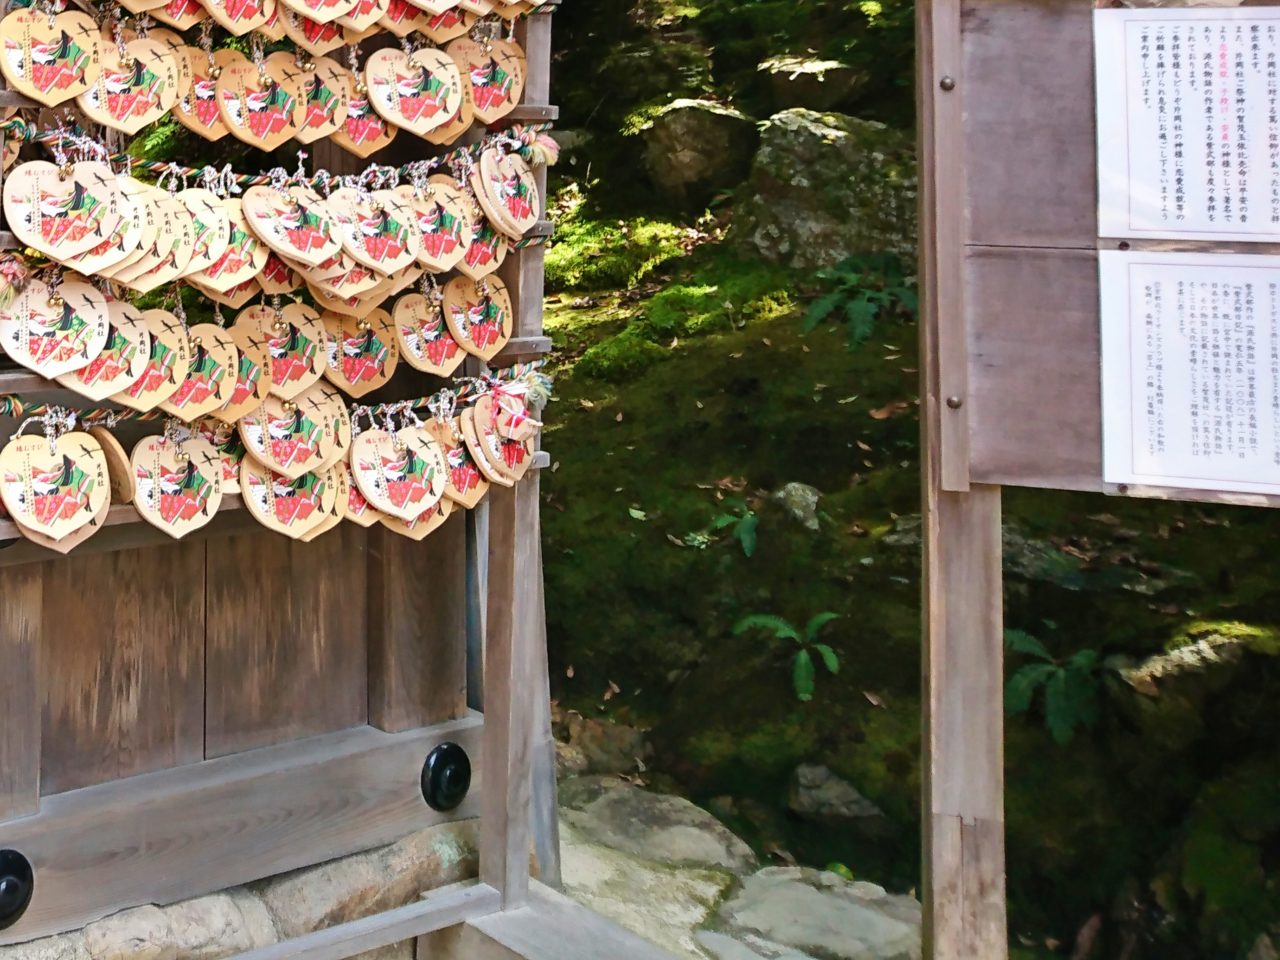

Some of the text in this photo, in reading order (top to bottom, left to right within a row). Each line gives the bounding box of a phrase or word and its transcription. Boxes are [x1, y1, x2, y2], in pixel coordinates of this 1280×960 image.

[16, 15, 43, 23] 縁むすび
[24, 169, 53, 177] 縁むすび
[145, 204, 154, 226] 片岡社
[164, 212, 172, 234] 片岡社
[178, 338, 186, 360] 片岡社
[262, 355, 270, 376] 片岡社
[338, 405, 347, 426] 片岡社
[323, 416, 331, 437] 片岡社
[16, 444, 43, 452] 縁むすび
